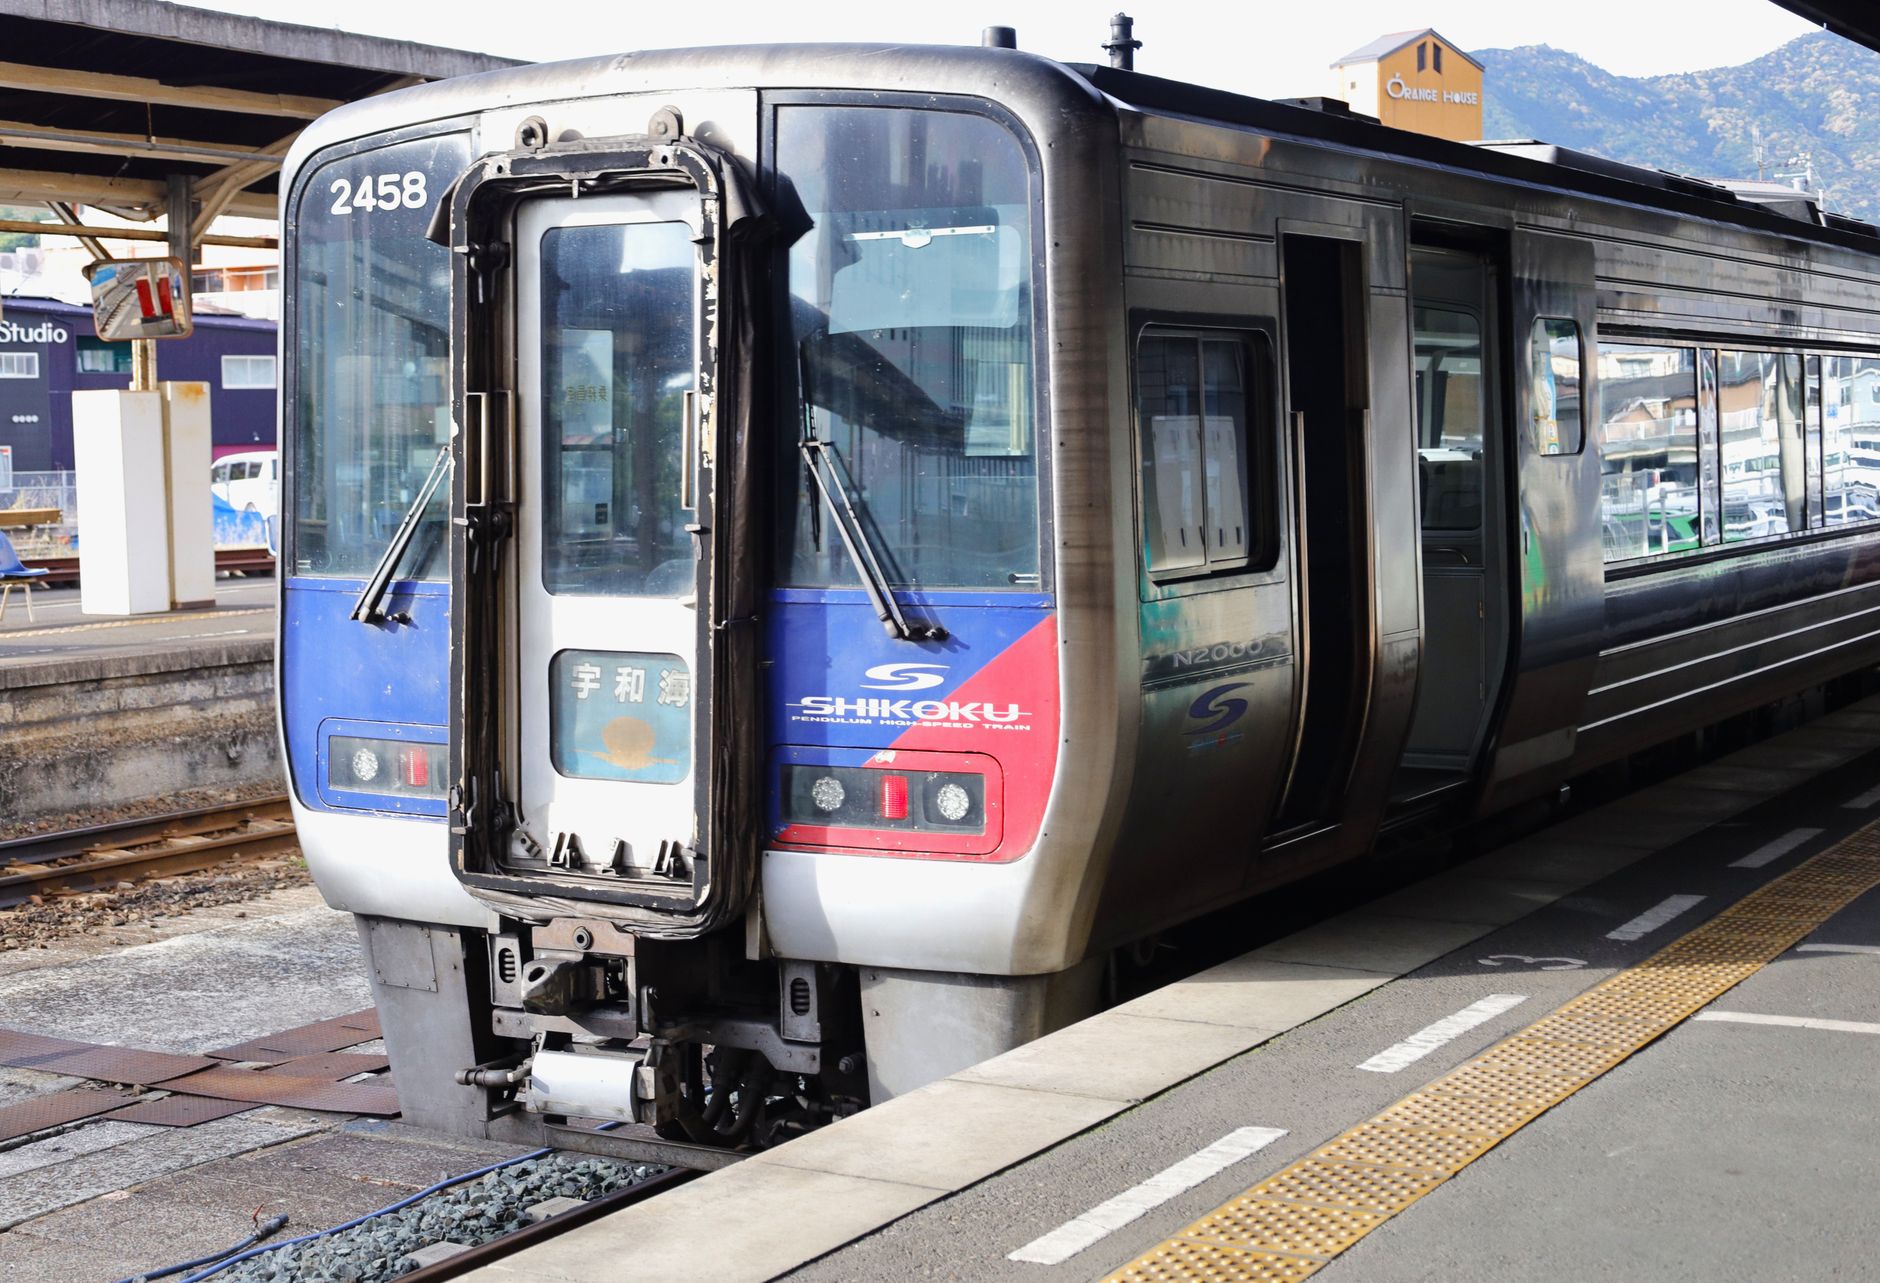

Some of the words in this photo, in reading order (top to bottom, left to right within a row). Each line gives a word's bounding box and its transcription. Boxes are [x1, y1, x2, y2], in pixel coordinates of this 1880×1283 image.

[330, 171, 428, 215] 2458
[0, 321, 68, 343] Studio
[1173, 641, 1264, 668] N2000
[570, 663, 690, 708] 宇和海
[801, 696, 1019, 722] SHIKOKU
[792, 715, 872, 725] PENDULUM
[880, 719, 975, 729] HIGH-SPEED
[982, 723, 1031, 731] TRAIN
